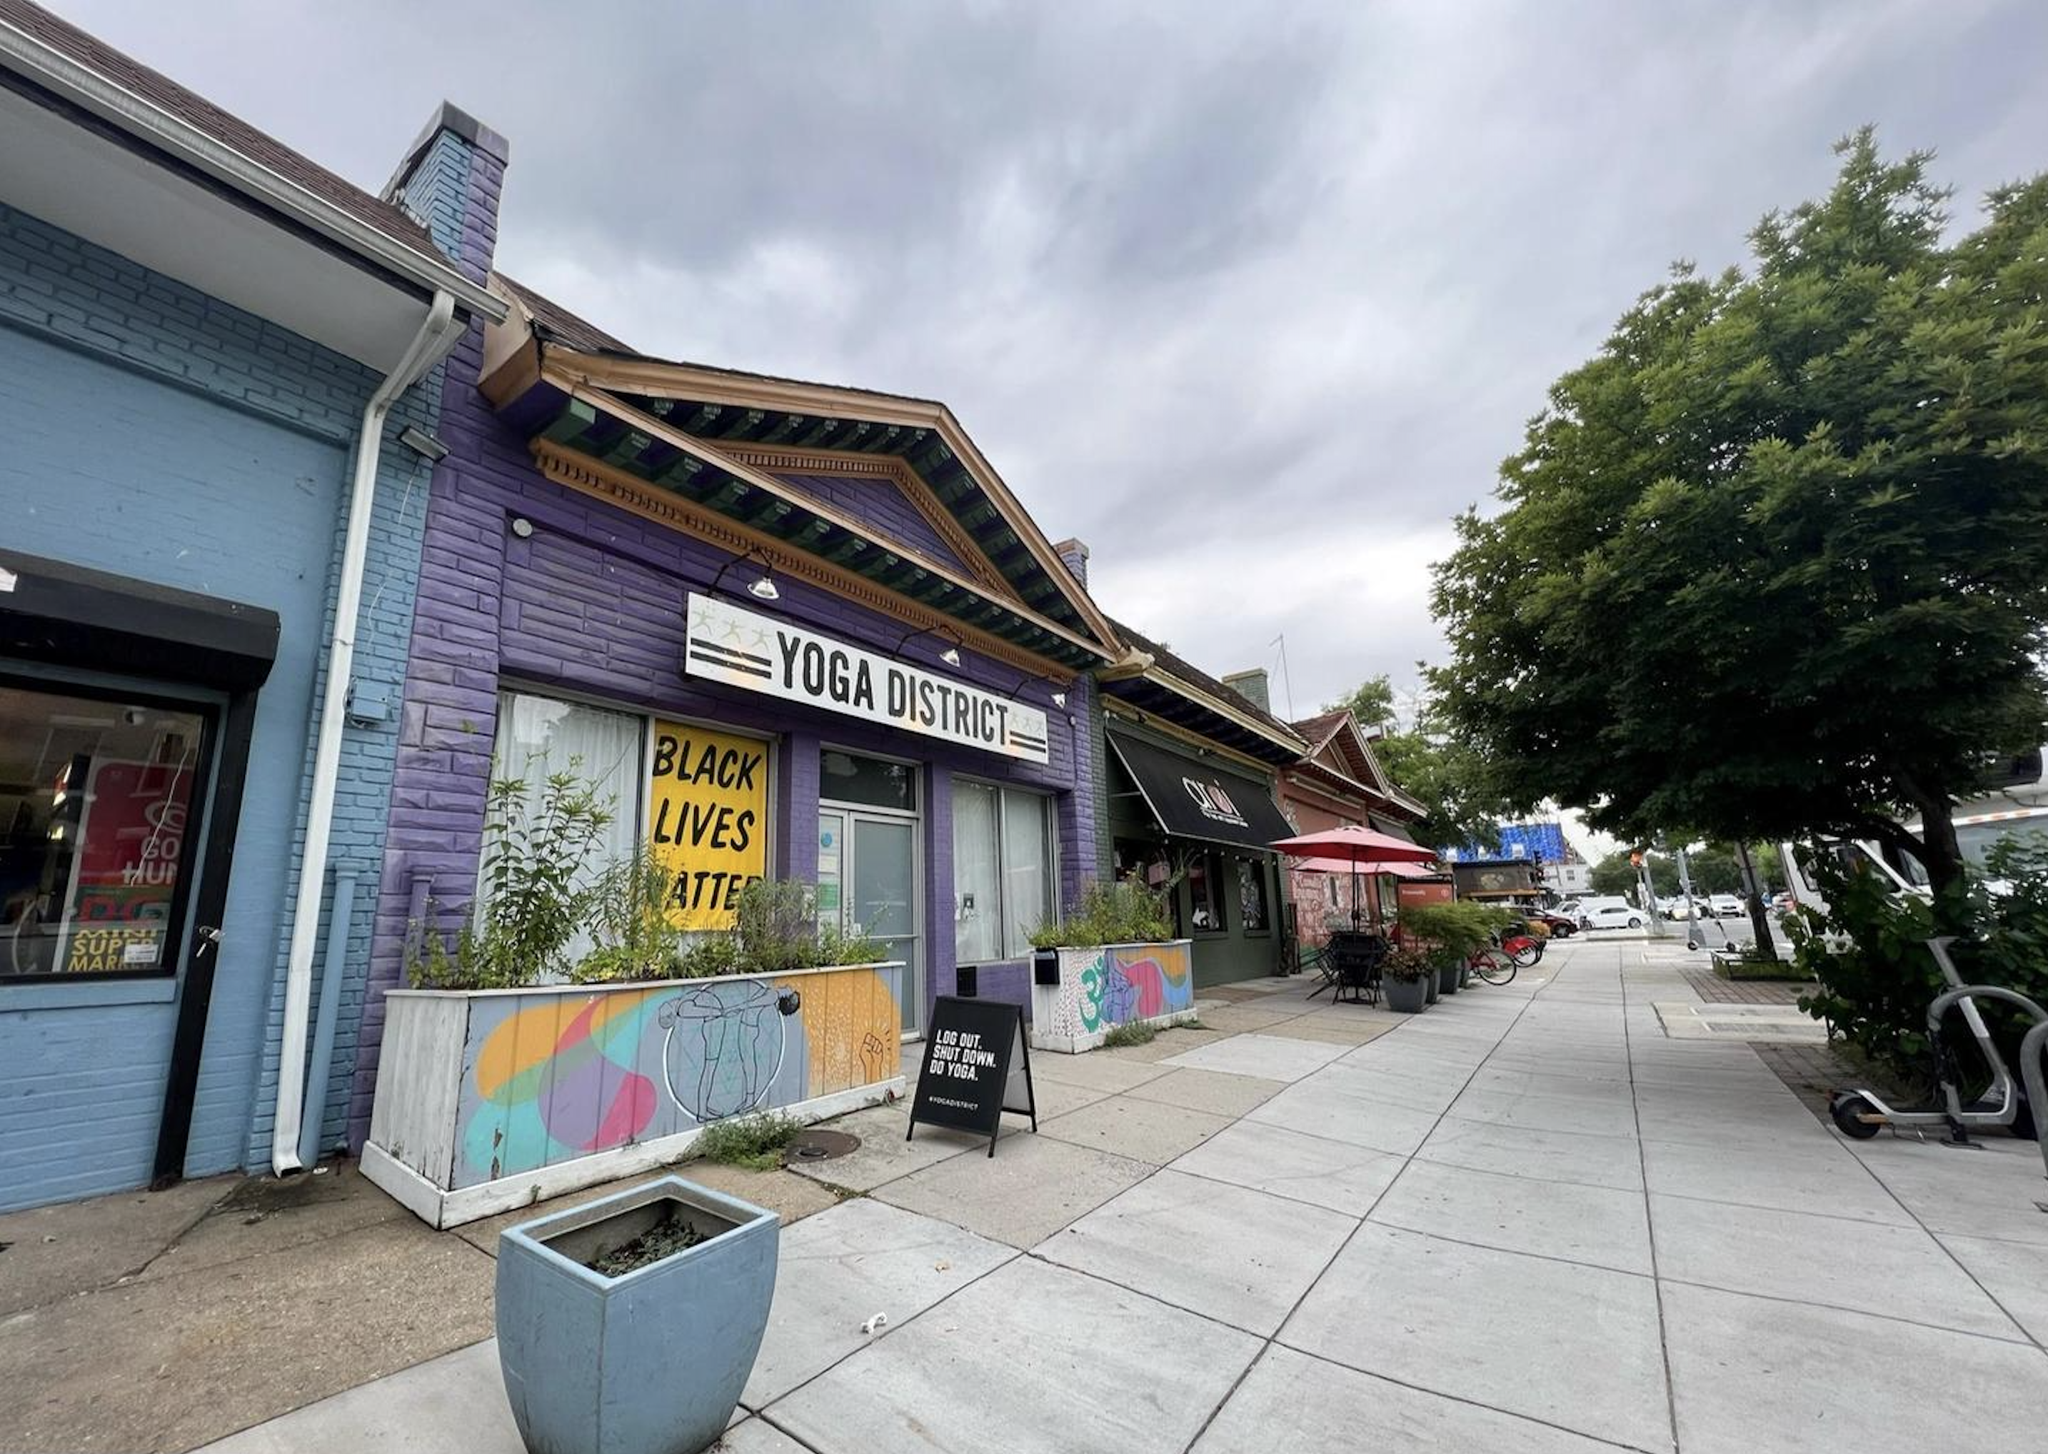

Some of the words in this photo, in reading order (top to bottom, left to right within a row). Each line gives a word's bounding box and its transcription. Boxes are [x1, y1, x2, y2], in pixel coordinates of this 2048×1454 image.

[776, 631, 874, 711] YOGA
[888, 668, 1009, 746] DISTRICT
[652, 735, 762, 792] BLACK
[654, 797, 755, 852] LIVES
[141, 836, 180, 860] GO
[657, 870, 763, 911] ATTE
[936, 1029, 958, 1046] LOG
[960, 1032, 982, 1050] OUT.
[929, 1060, 945, 1075] DO
[947, 1062, 979, 1081] YOGA.
[933, 1045, 961, 1061] SHUT
[962, 1048, 997, 1068] DOWN.
